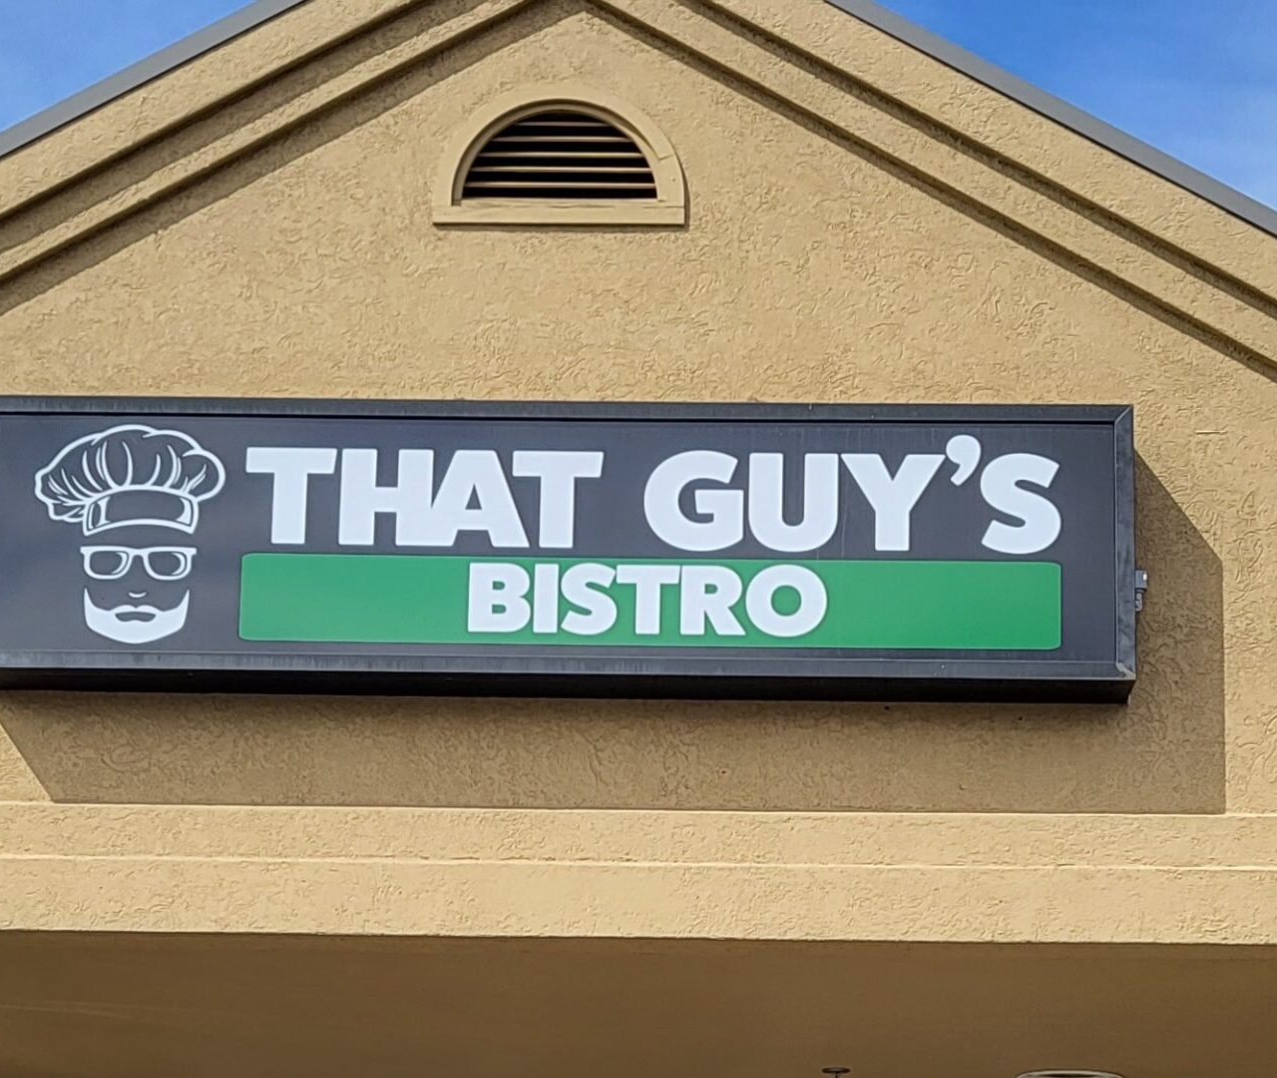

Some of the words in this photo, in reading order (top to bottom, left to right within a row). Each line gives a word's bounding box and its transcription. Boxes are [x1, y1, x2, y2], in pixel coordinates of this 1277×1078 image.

[245, 446, 604, 549] THAT
[643, 434, 1062, 555] GUY'S
[466, 562, 829, 637] BISTRO
